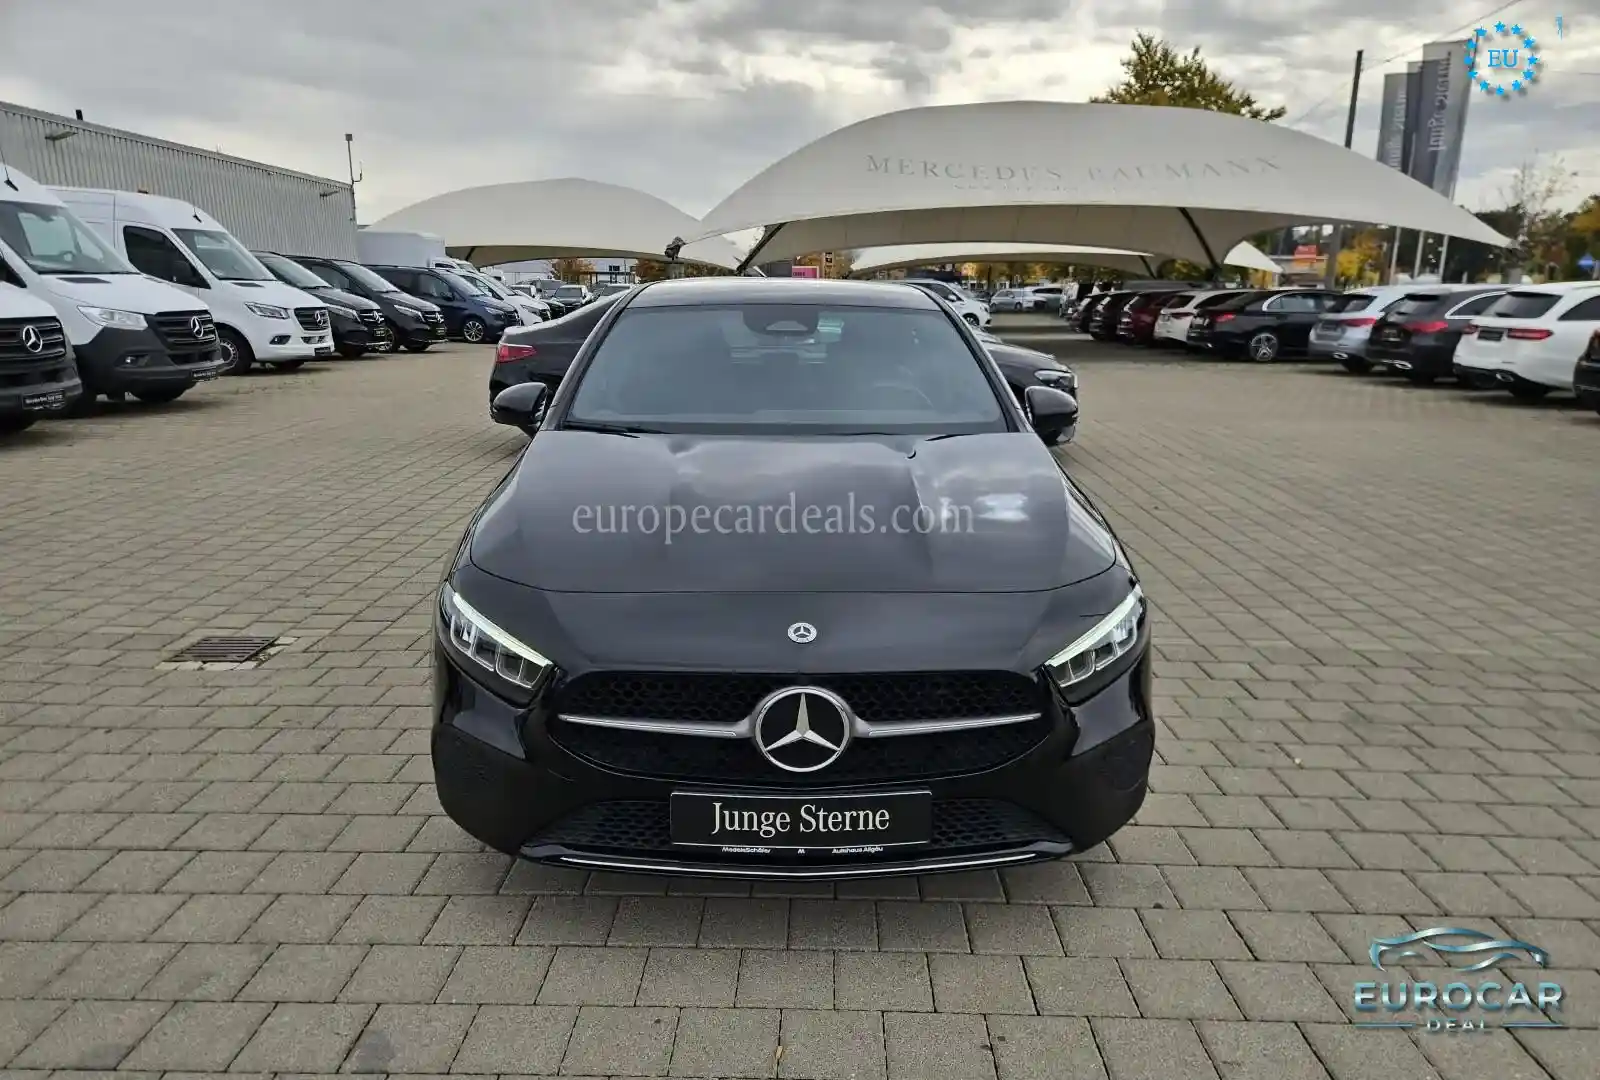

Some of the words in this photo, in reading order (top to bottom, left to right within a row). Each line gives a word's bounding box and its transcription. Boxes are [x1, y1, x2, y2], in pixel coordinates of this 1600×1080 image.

[865, 154, 1063, 181] MERCEDES
[711, 802, 791, 838] Junge
[799, 804, 890, 832] Sterne
